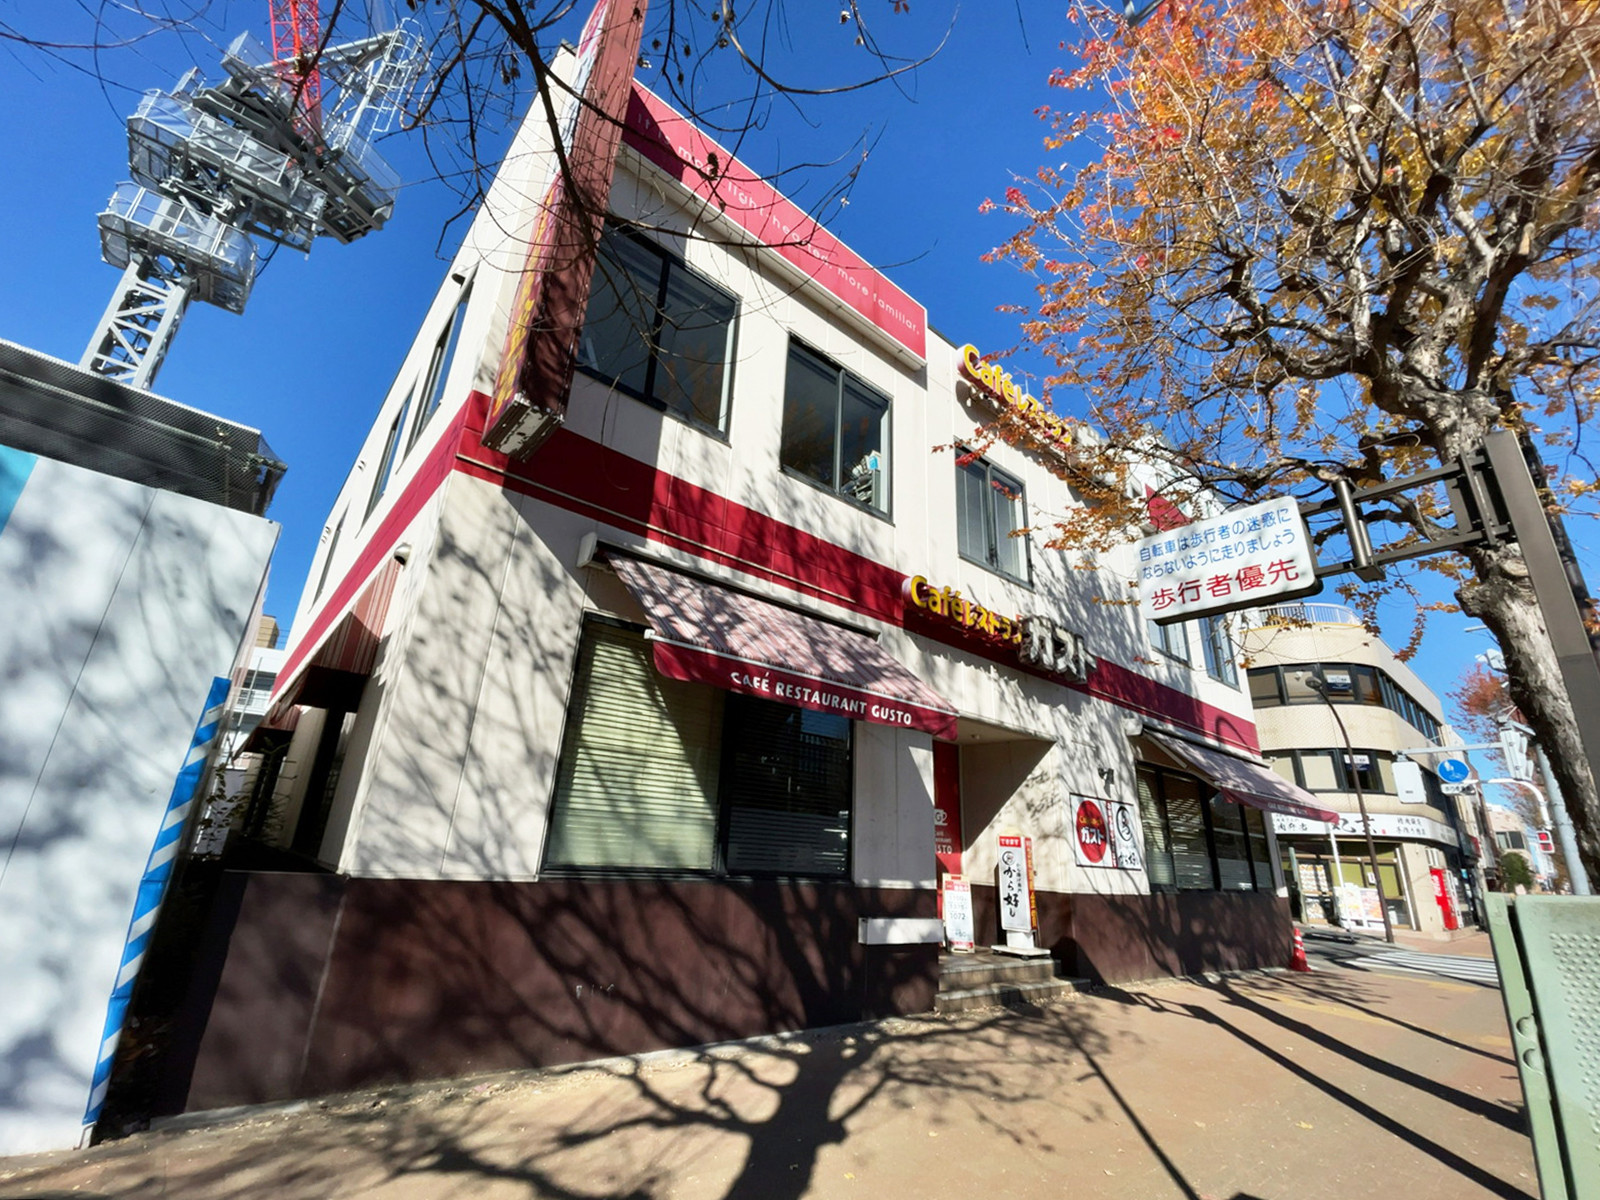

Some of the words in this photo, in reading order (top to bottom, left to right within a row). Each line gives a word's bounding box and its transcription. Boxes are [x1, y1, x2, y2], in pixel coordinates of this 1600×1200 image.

[678, 146, 720, 182] mor
[837, 267, 869, 297] more
[1139, 507, 1292, 562] 自転車は歩行者の迷惑に
[1141, 529, 1296, 580] ならないように走りましょう
[1151, 558, 1300, 611] 歩行者優先
[730, 671, 770, 693] CAFÉ
[775, 681, 868, 714] RESTAURANT
[871, 704, 912, 725] GUSTO
[1081, 826, 1105, 846] ガスト
[1003, 866, 1020, 918] から好し
